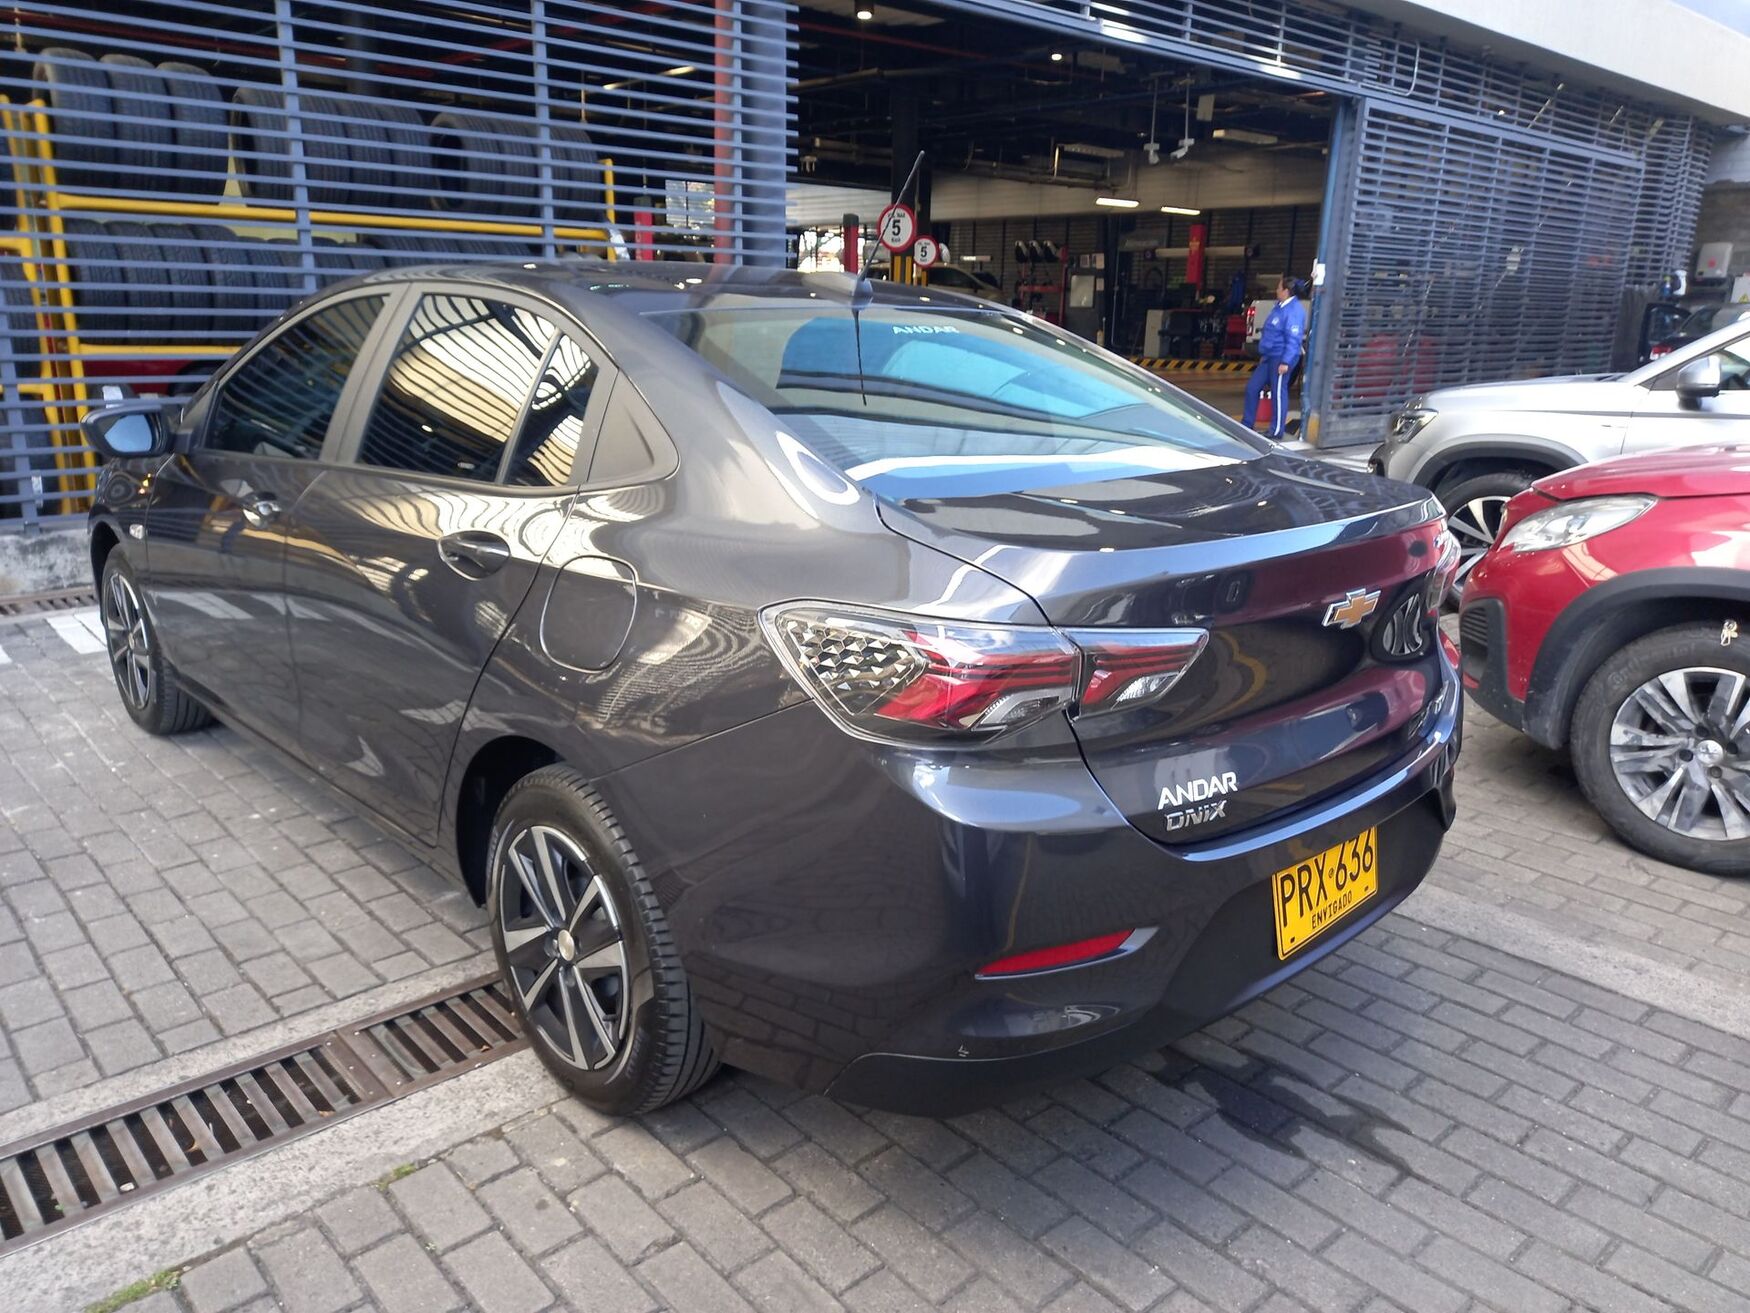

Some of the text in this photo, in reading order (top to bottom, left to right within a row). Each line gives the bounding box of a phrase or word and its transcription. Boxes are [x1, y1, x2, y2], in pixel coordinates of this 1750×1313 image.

[892, 219, 901, 236] 5
[920, 246, 927, 257] 5
[1157, 771, 1238, 810] ANDAR
[1164, 800, 1227, 831] ONIX
[1280, 828, 1374, 928] PRX 636
[1311, 890, 1353, 929] ENVIGADO
